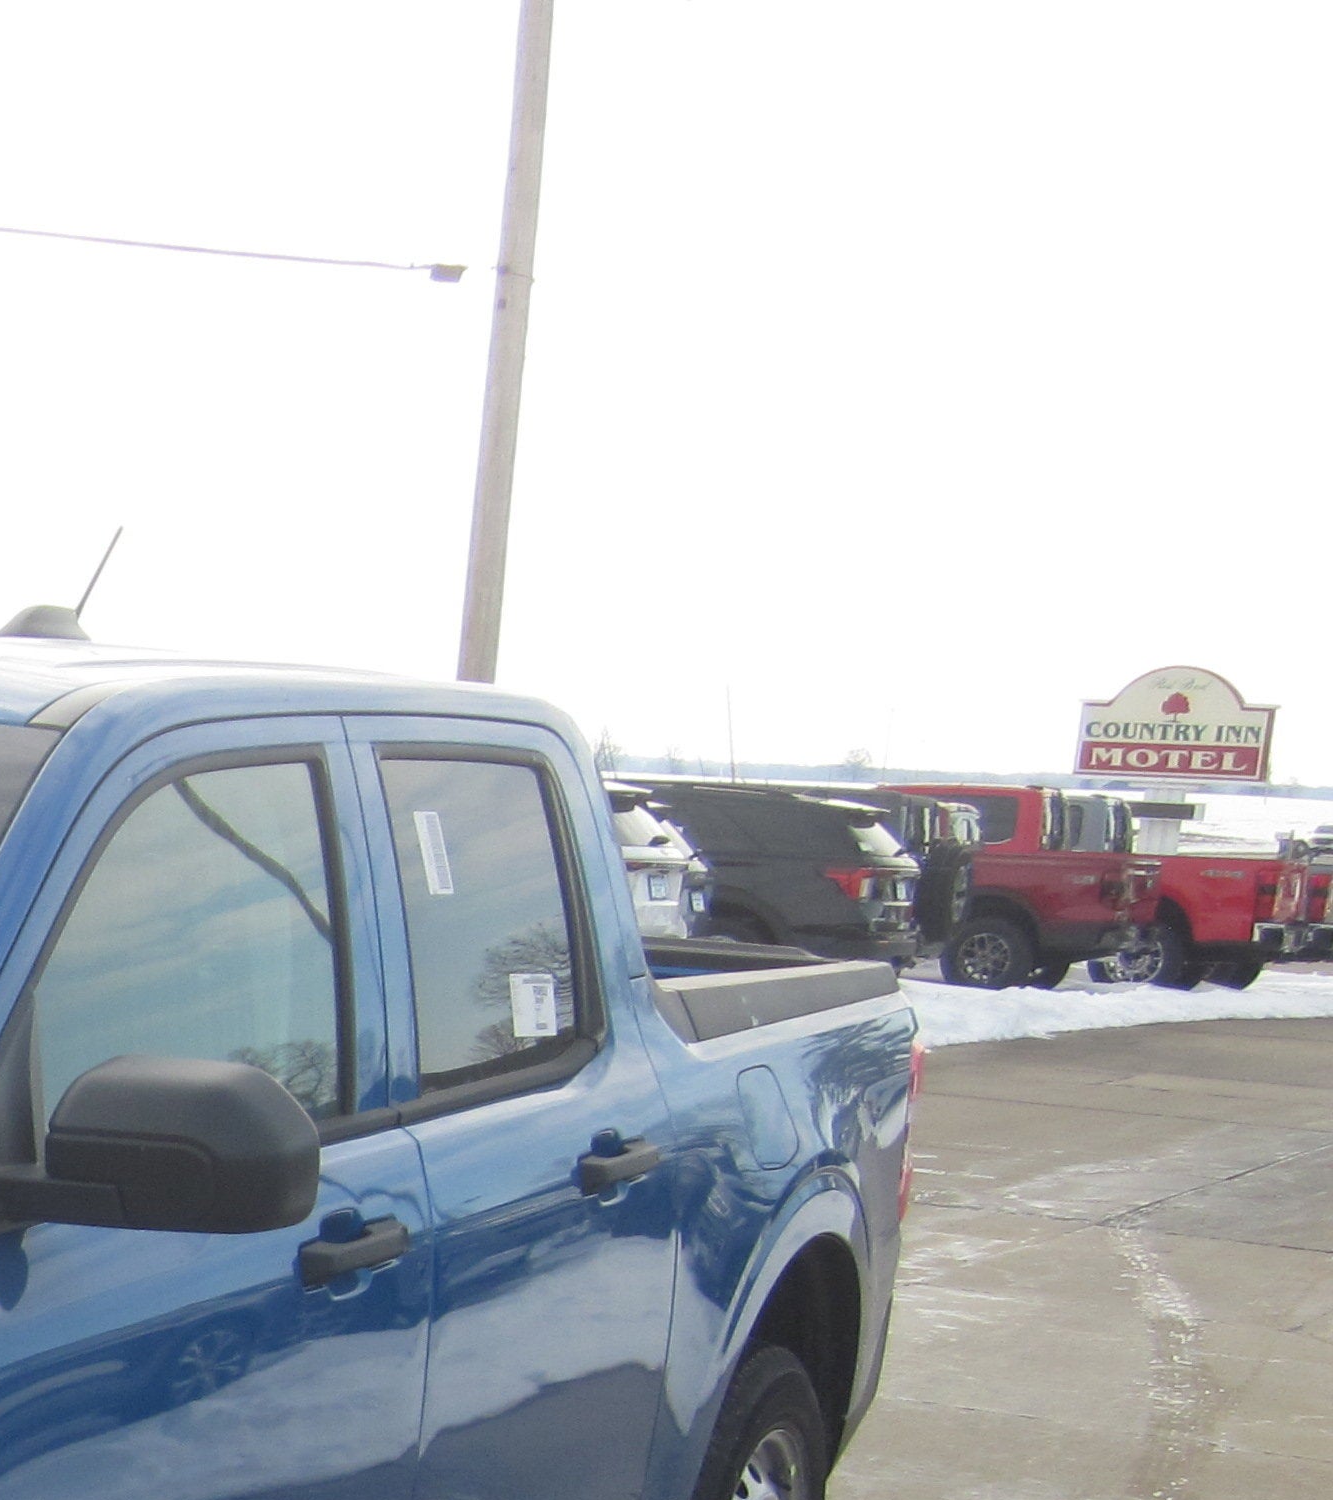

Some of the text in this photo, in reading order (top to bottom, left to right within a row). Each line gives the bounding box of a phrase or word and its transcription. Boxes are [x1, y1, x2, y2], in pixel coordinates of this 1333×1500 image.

[1086, 721, 1262, 743] COUNTRY INN
[1089, 747, 1247, 771] MOTEL
